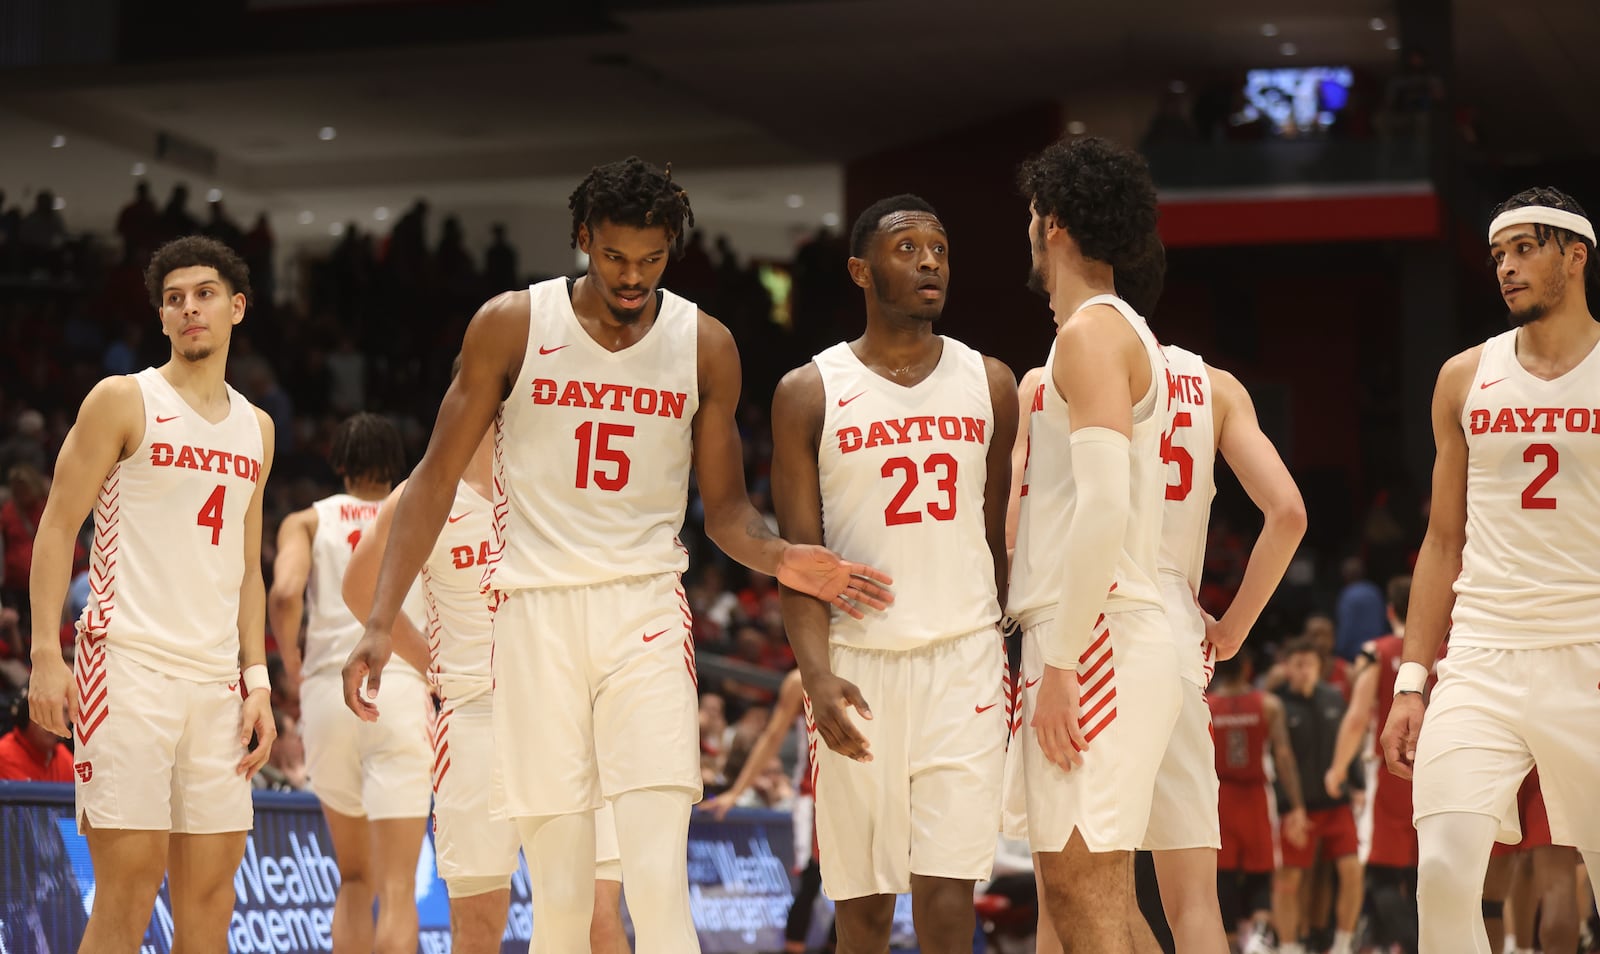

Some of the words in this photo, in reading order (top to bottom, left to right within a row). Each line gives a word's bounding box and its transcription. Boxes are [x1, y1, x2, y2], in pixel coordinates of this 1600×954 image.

[531, 378, 687, 419] DAYTON
[574, 421, 635, 491] 15
[836, 416, 986, 454] DAYTON
[881, 452, 958, 527] 23
[1521, 443, 1559, 510] 2
[197, 484, 226, 546] 4
